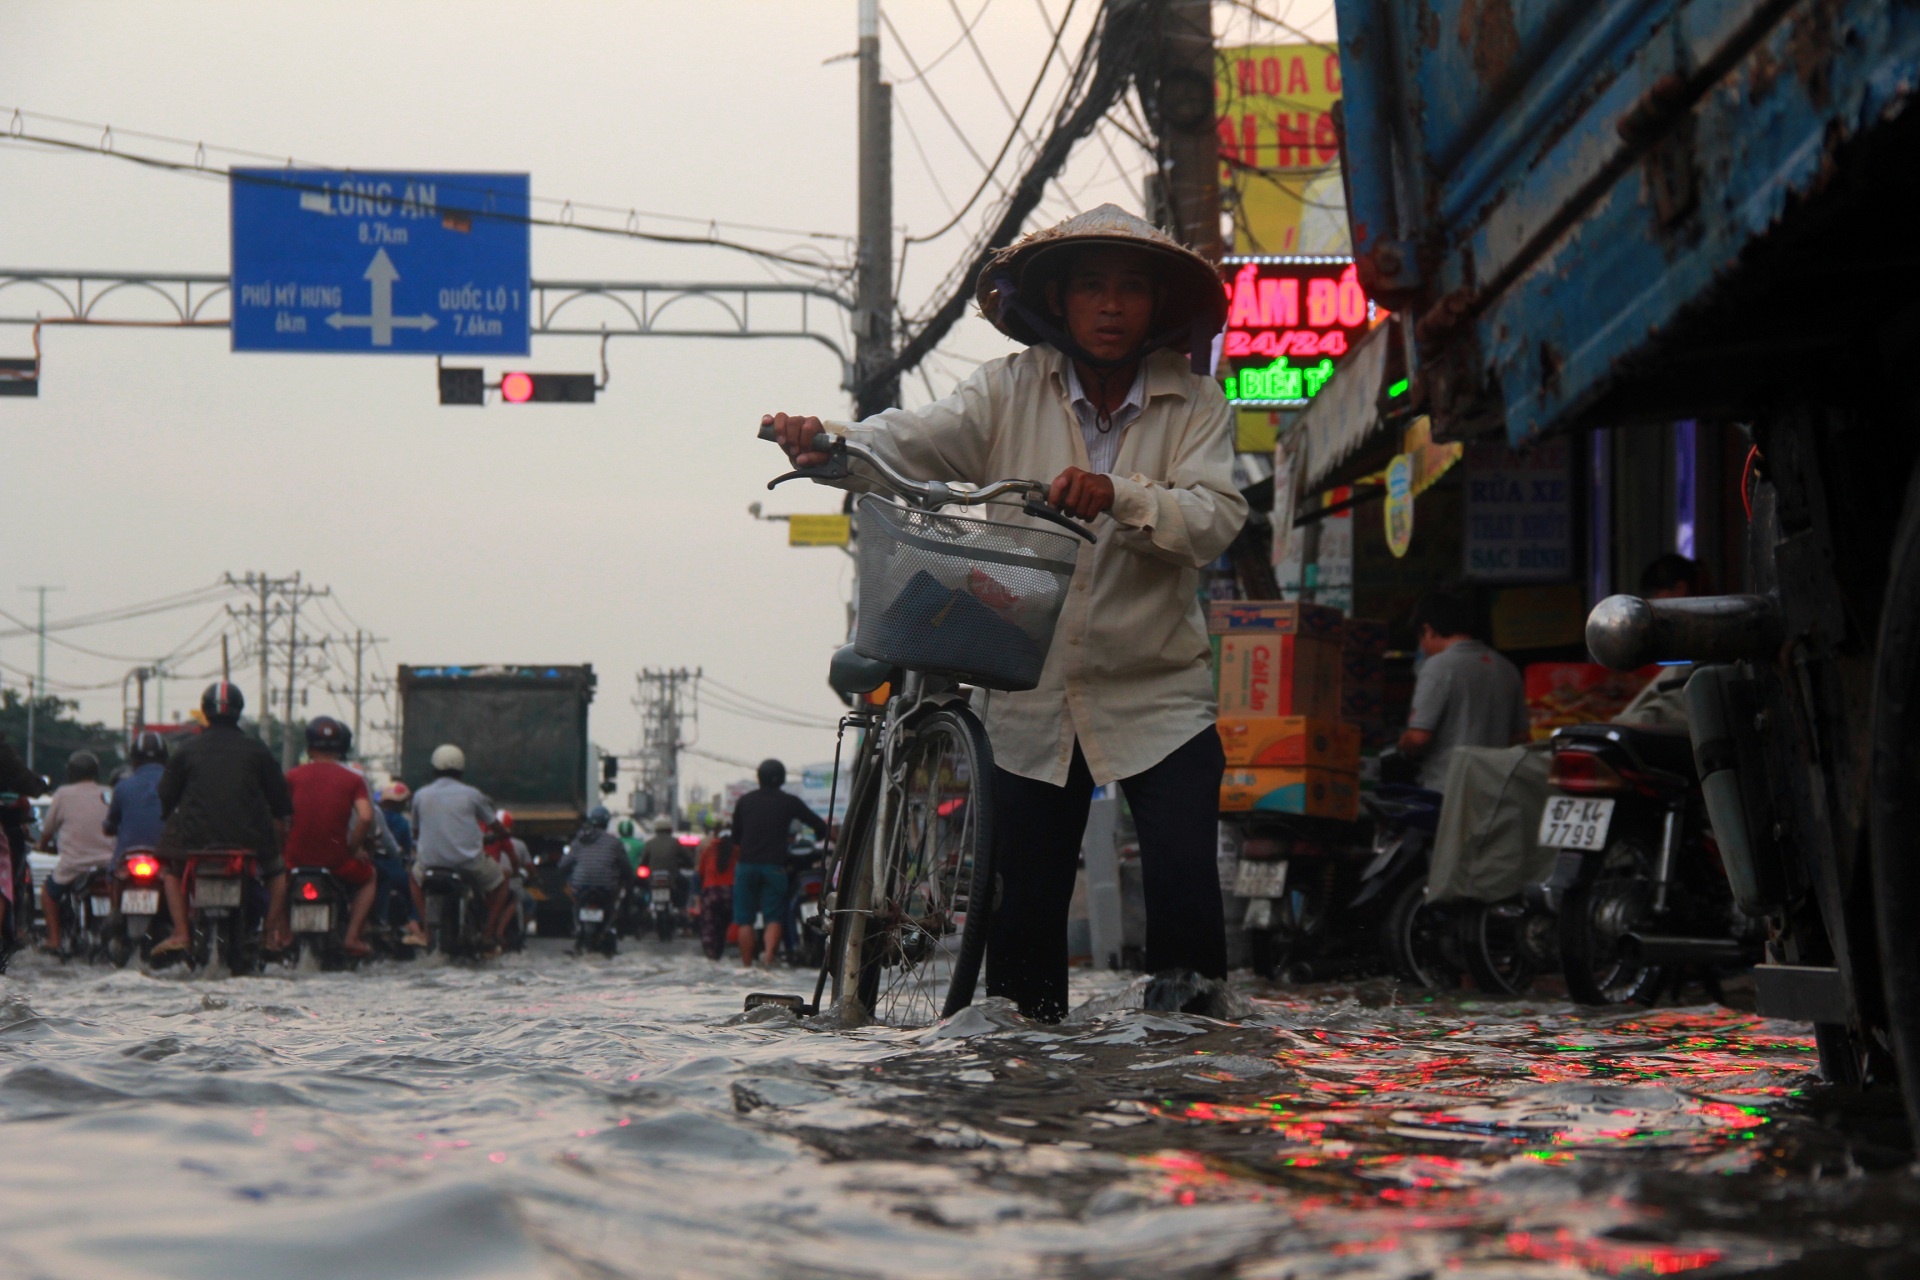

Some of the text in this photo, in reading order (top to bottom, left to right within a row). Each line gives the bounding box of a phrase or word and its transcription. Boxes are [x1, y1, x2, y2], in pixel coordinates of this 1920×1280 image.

[322, 181, 437, 219] LONG AN
[358, 222, 408, 245] 8.7km
[241, 280, 271, 308] PHÚ
[275, 281, 296, 308] MỸ
[439, 281, 482, 312] QUỐC
[512, 288, 519, 312] 1
[275, 310, 307, 333] 6km
[453, 312, 503, 336] 7.6km
[1225, 330, 1348, 357] 24/24
[1546, 823, 1596, 846] 7799
